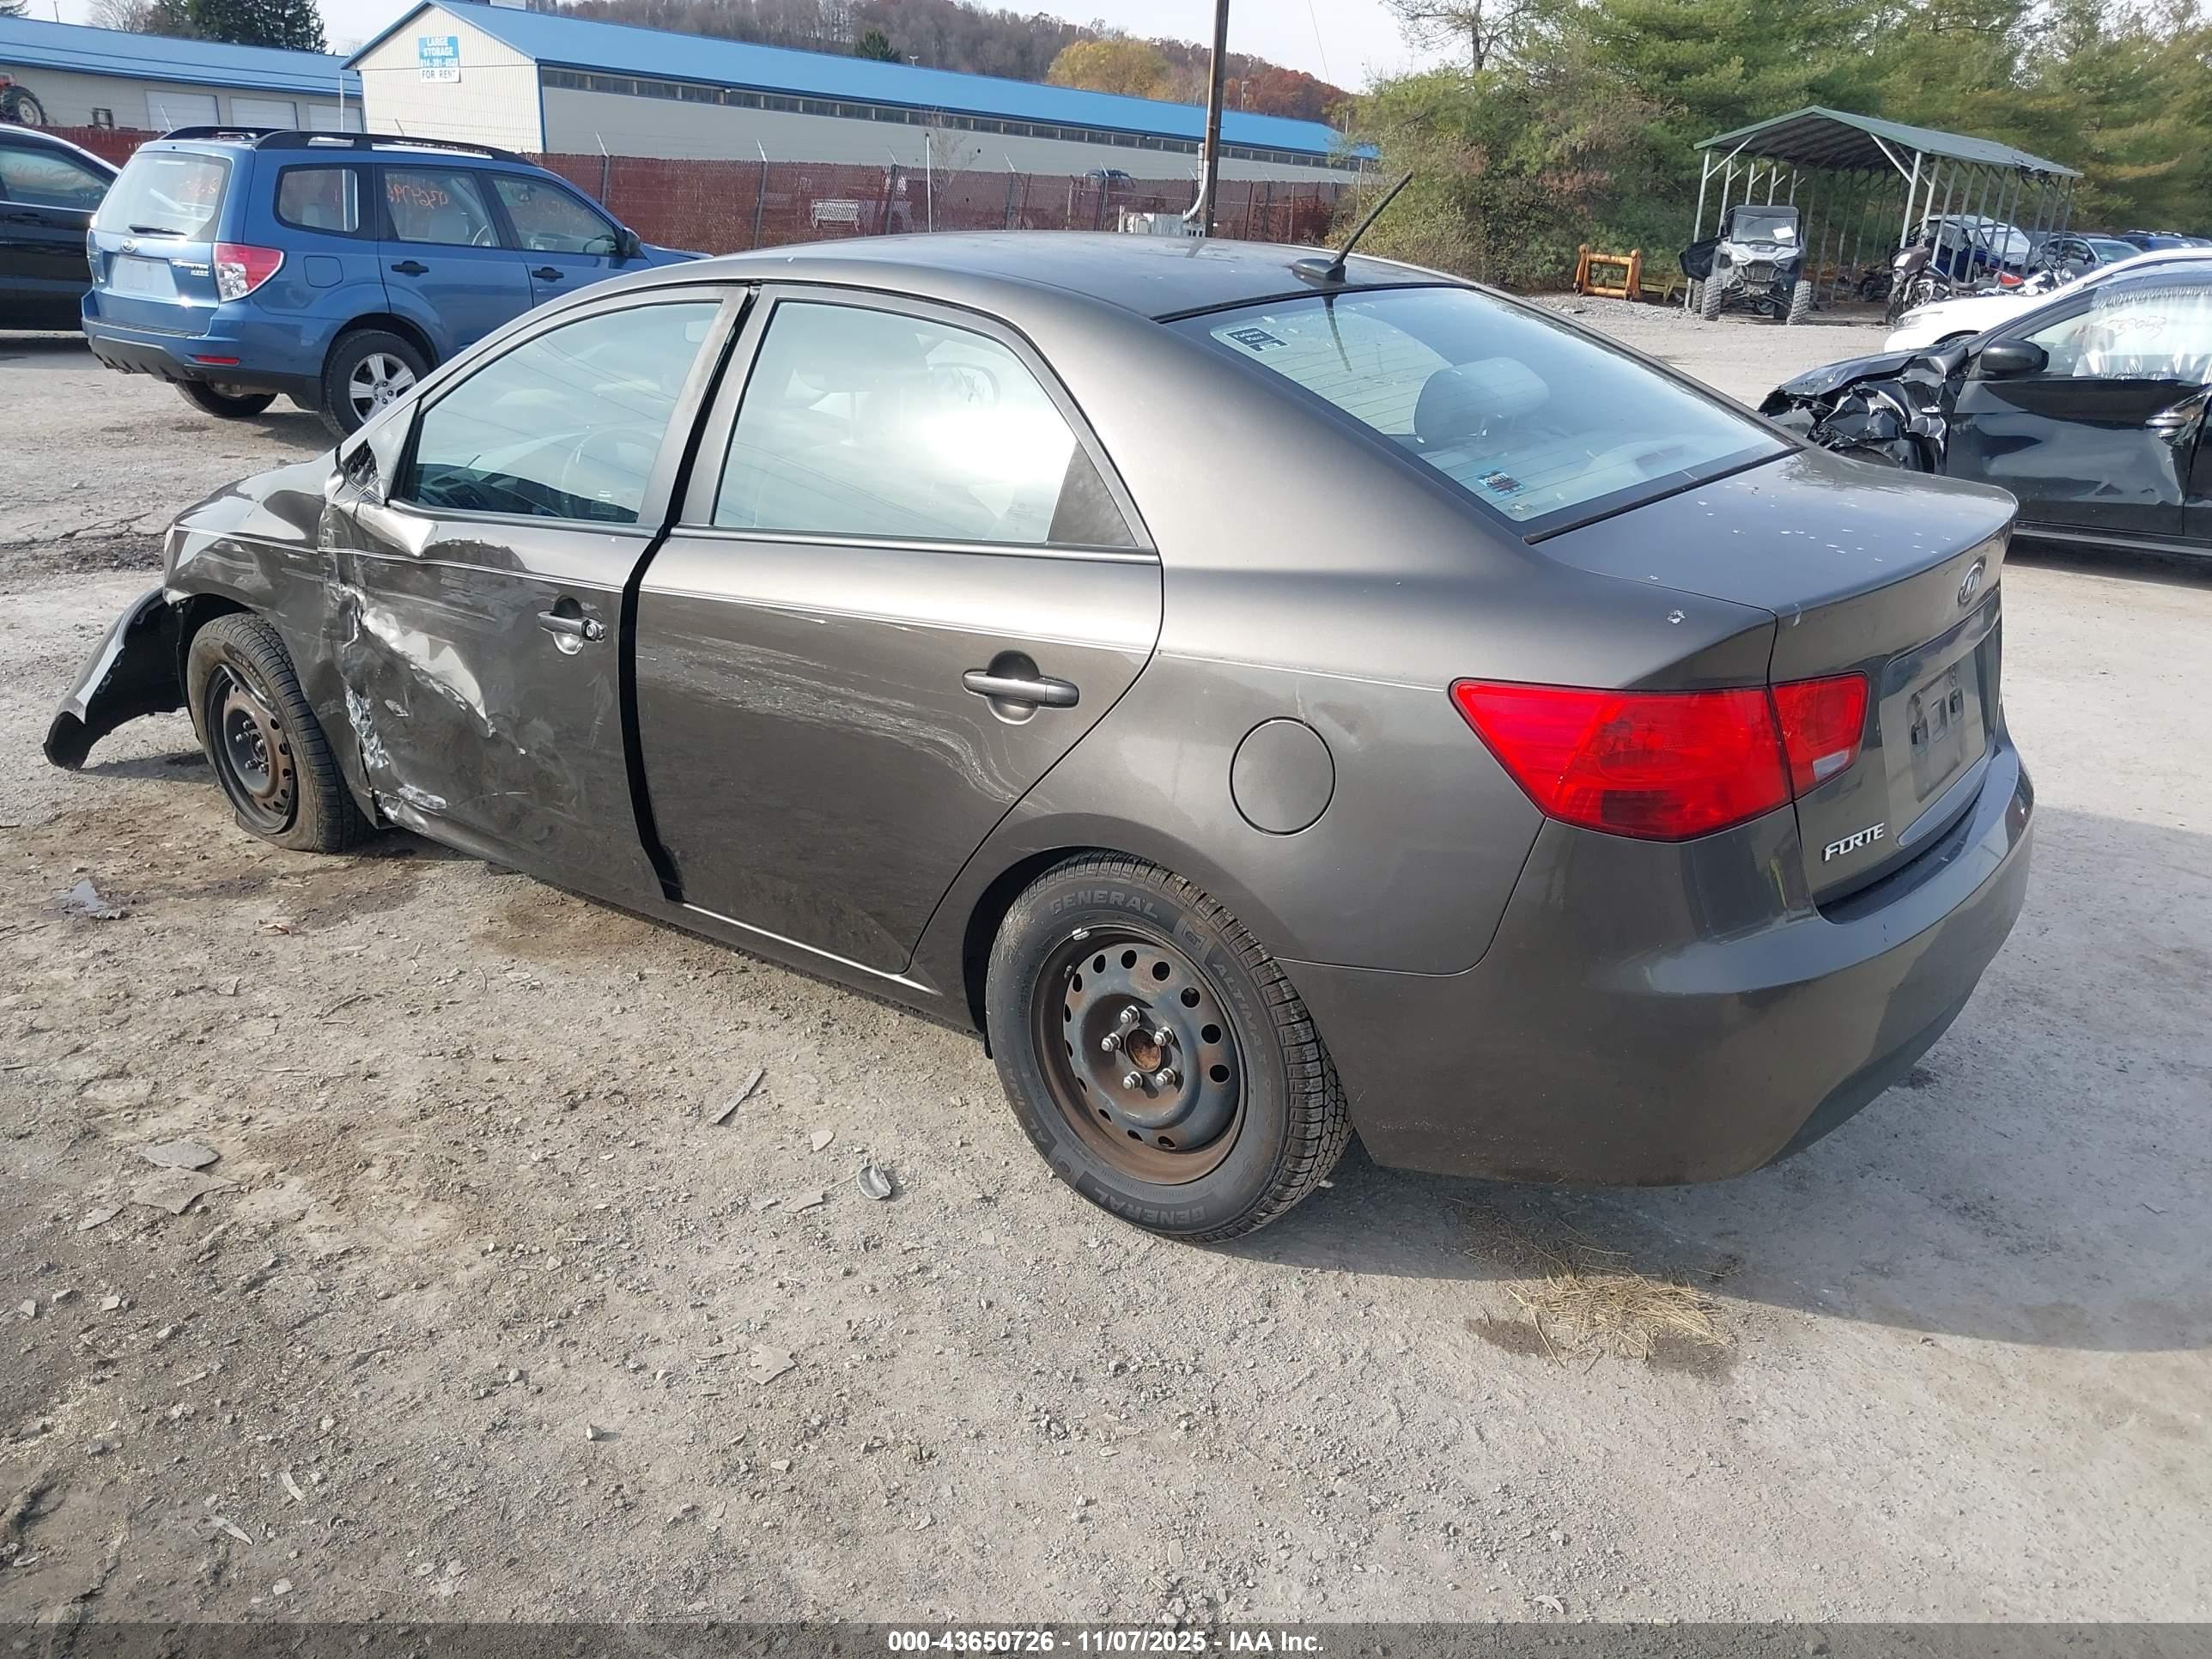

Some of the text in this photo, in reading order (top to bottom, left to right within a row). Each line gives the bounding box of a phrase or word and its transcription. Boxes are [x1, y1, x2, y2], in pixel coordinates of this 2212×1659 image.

[423, 46, 454, 57] STORAGE
[427, 37, 449, 47] LARGE
[422, 70, 457, 80] FOR RENT
[1824, 822, 1885, 861] FORTE
[1050, 890, 1158, 919] GENERAL
[1094, 1187, 1207, 1225] GENERAL
